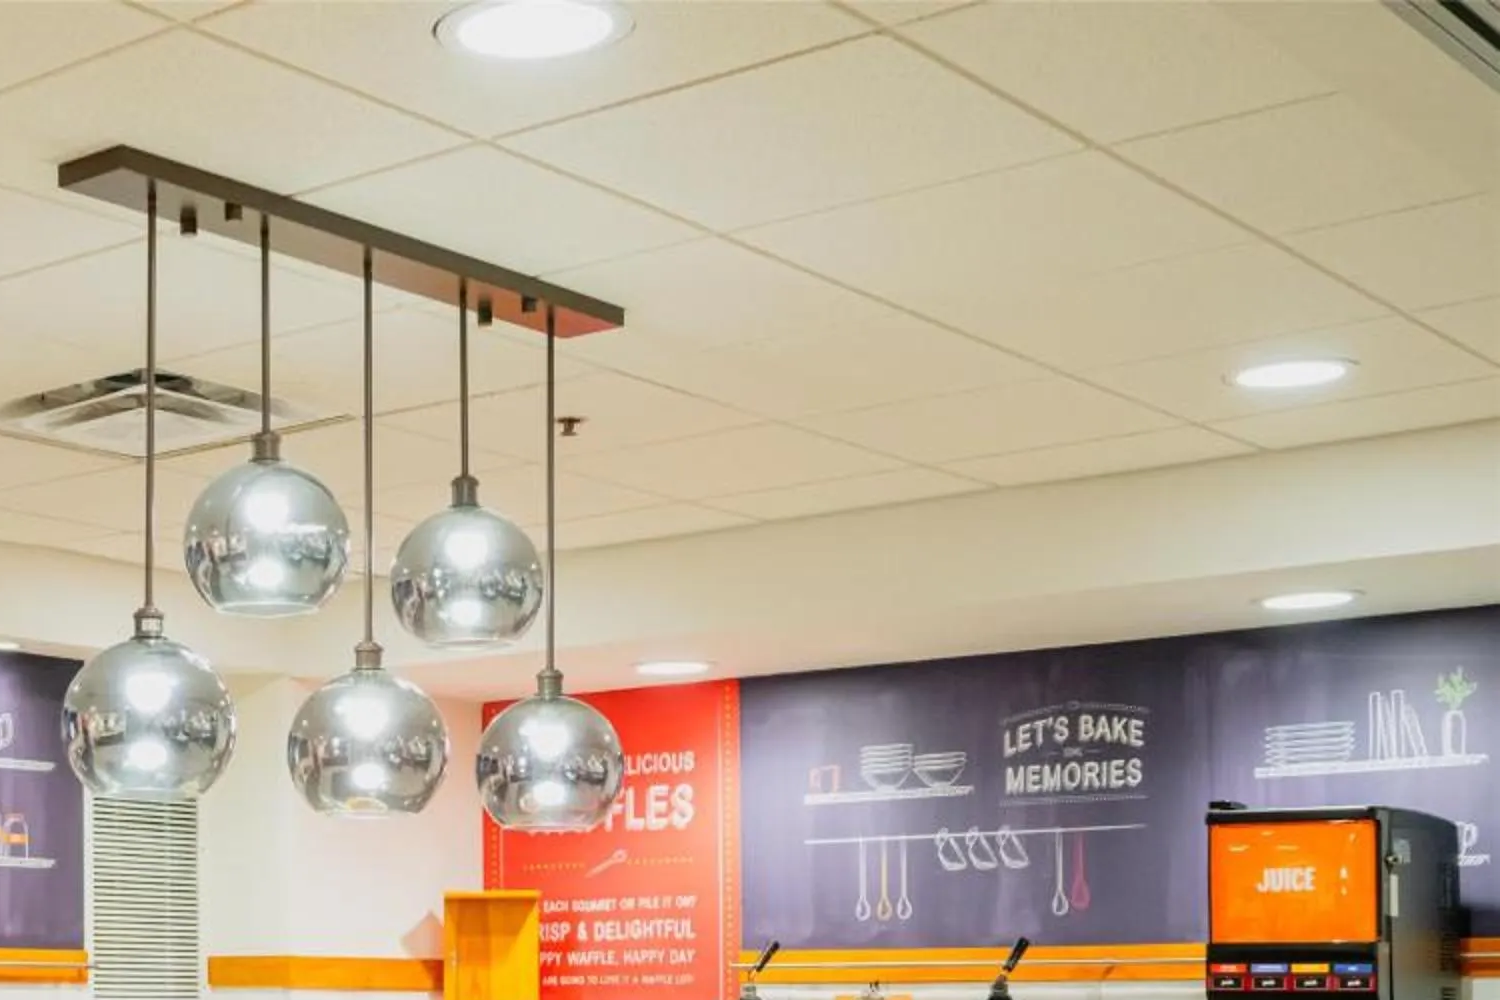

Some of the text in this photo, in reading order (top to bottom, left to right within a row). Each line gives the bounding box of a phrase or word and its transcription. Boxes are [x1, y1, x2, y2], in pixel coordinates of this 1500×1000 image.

[1003, 714, 1145, 758] LET'S BAKE
[623, 750, 695, 775] LICIOUS
[1005, 757, 1143, 795] MEMORIES
[1256, 867, 1316, 892] JUICE
[539, 921, 571, 941] RISP
[594, 918, 697, 942] DELIGHTFUL
[540, 951, 562, 966] PPY
[623, 949, 666, 966] HAPPY
[669, 948, 696, 965] DAY
